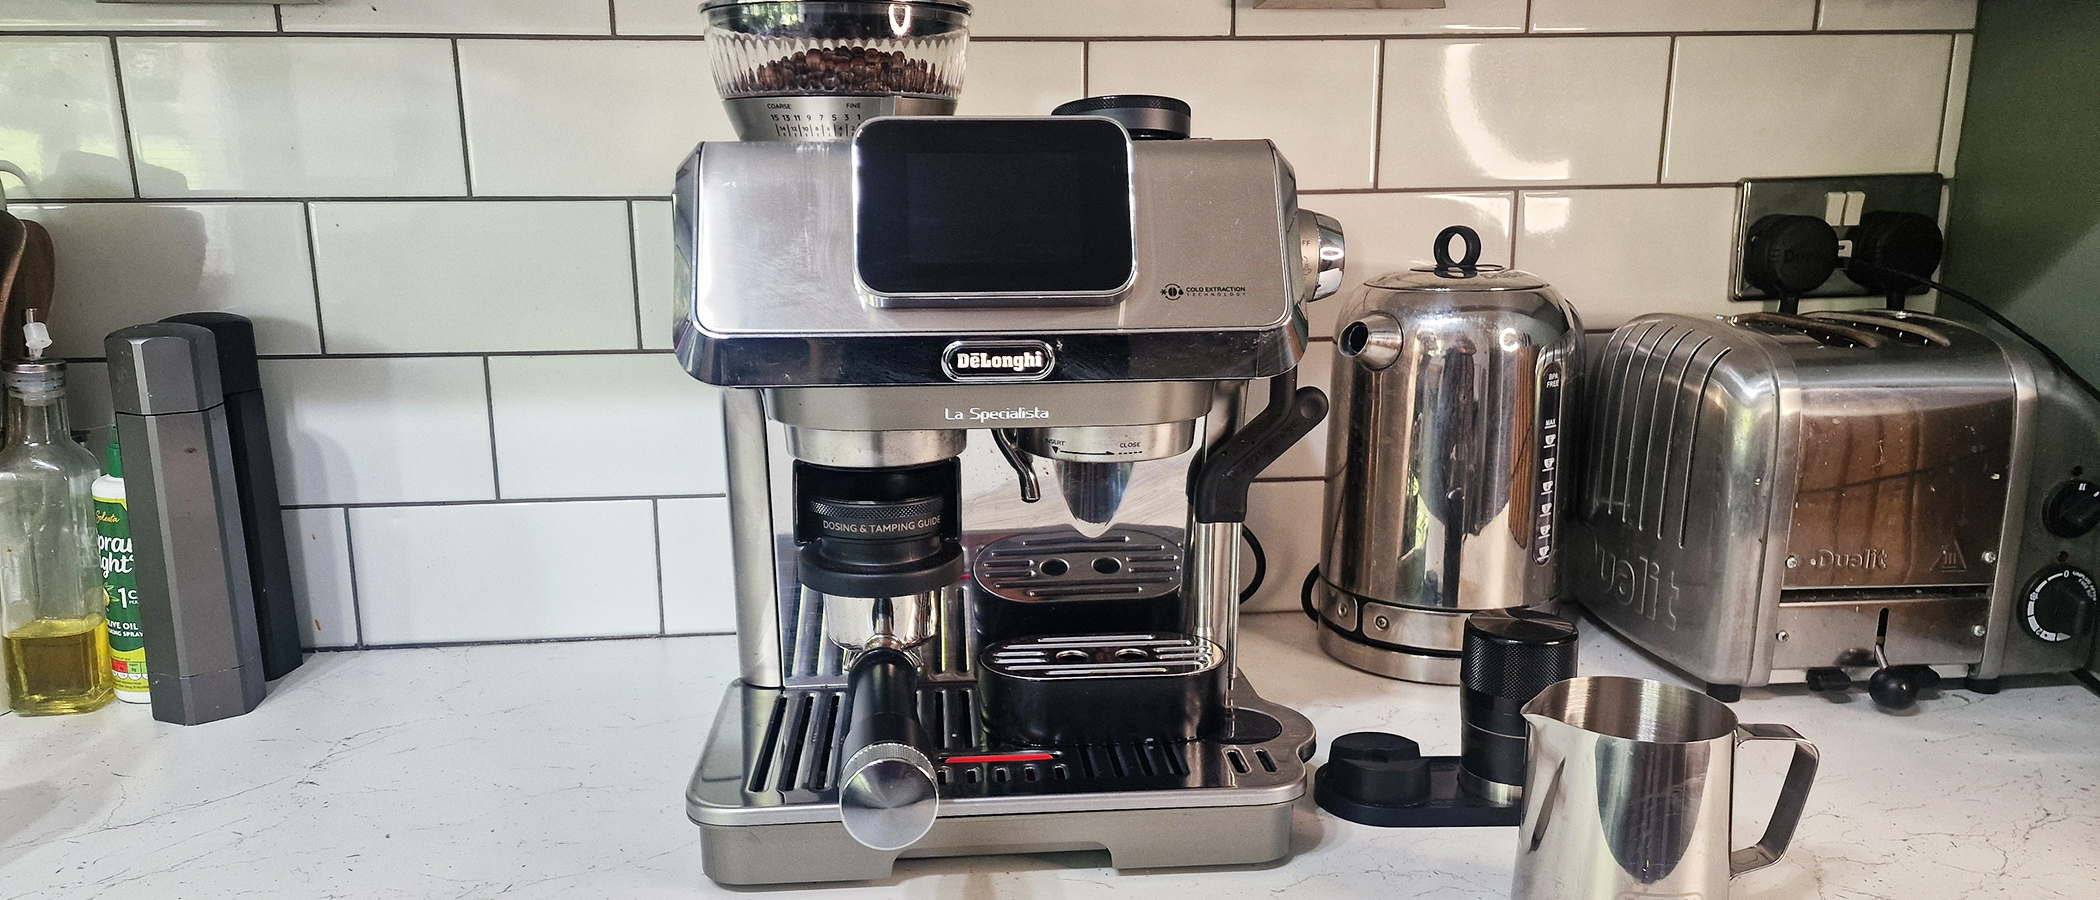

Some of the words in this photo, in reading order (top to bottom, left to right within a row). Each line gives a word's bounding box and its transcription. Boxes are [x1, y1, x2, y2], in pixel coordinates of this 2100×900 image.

[1546, 380, 1560, 388] FREE
[945, 407, 964, 420] La
[969, 406, 1050, 423] Specialista
[1545, 418, 1556, 426] MAX
[823, 520, 857, 533] DOSING
[859, 524, 868, 533] &
[869, 521, 915, 533] TAMPING
[917, 515, 941, 529] GUIDE
[1818, 549, 1888, 571] Dualit
[1594, 535, 1680, 631] ualit
[106, 618, 121, 629] LIVE
[122, 622, 138, 630] OIL
